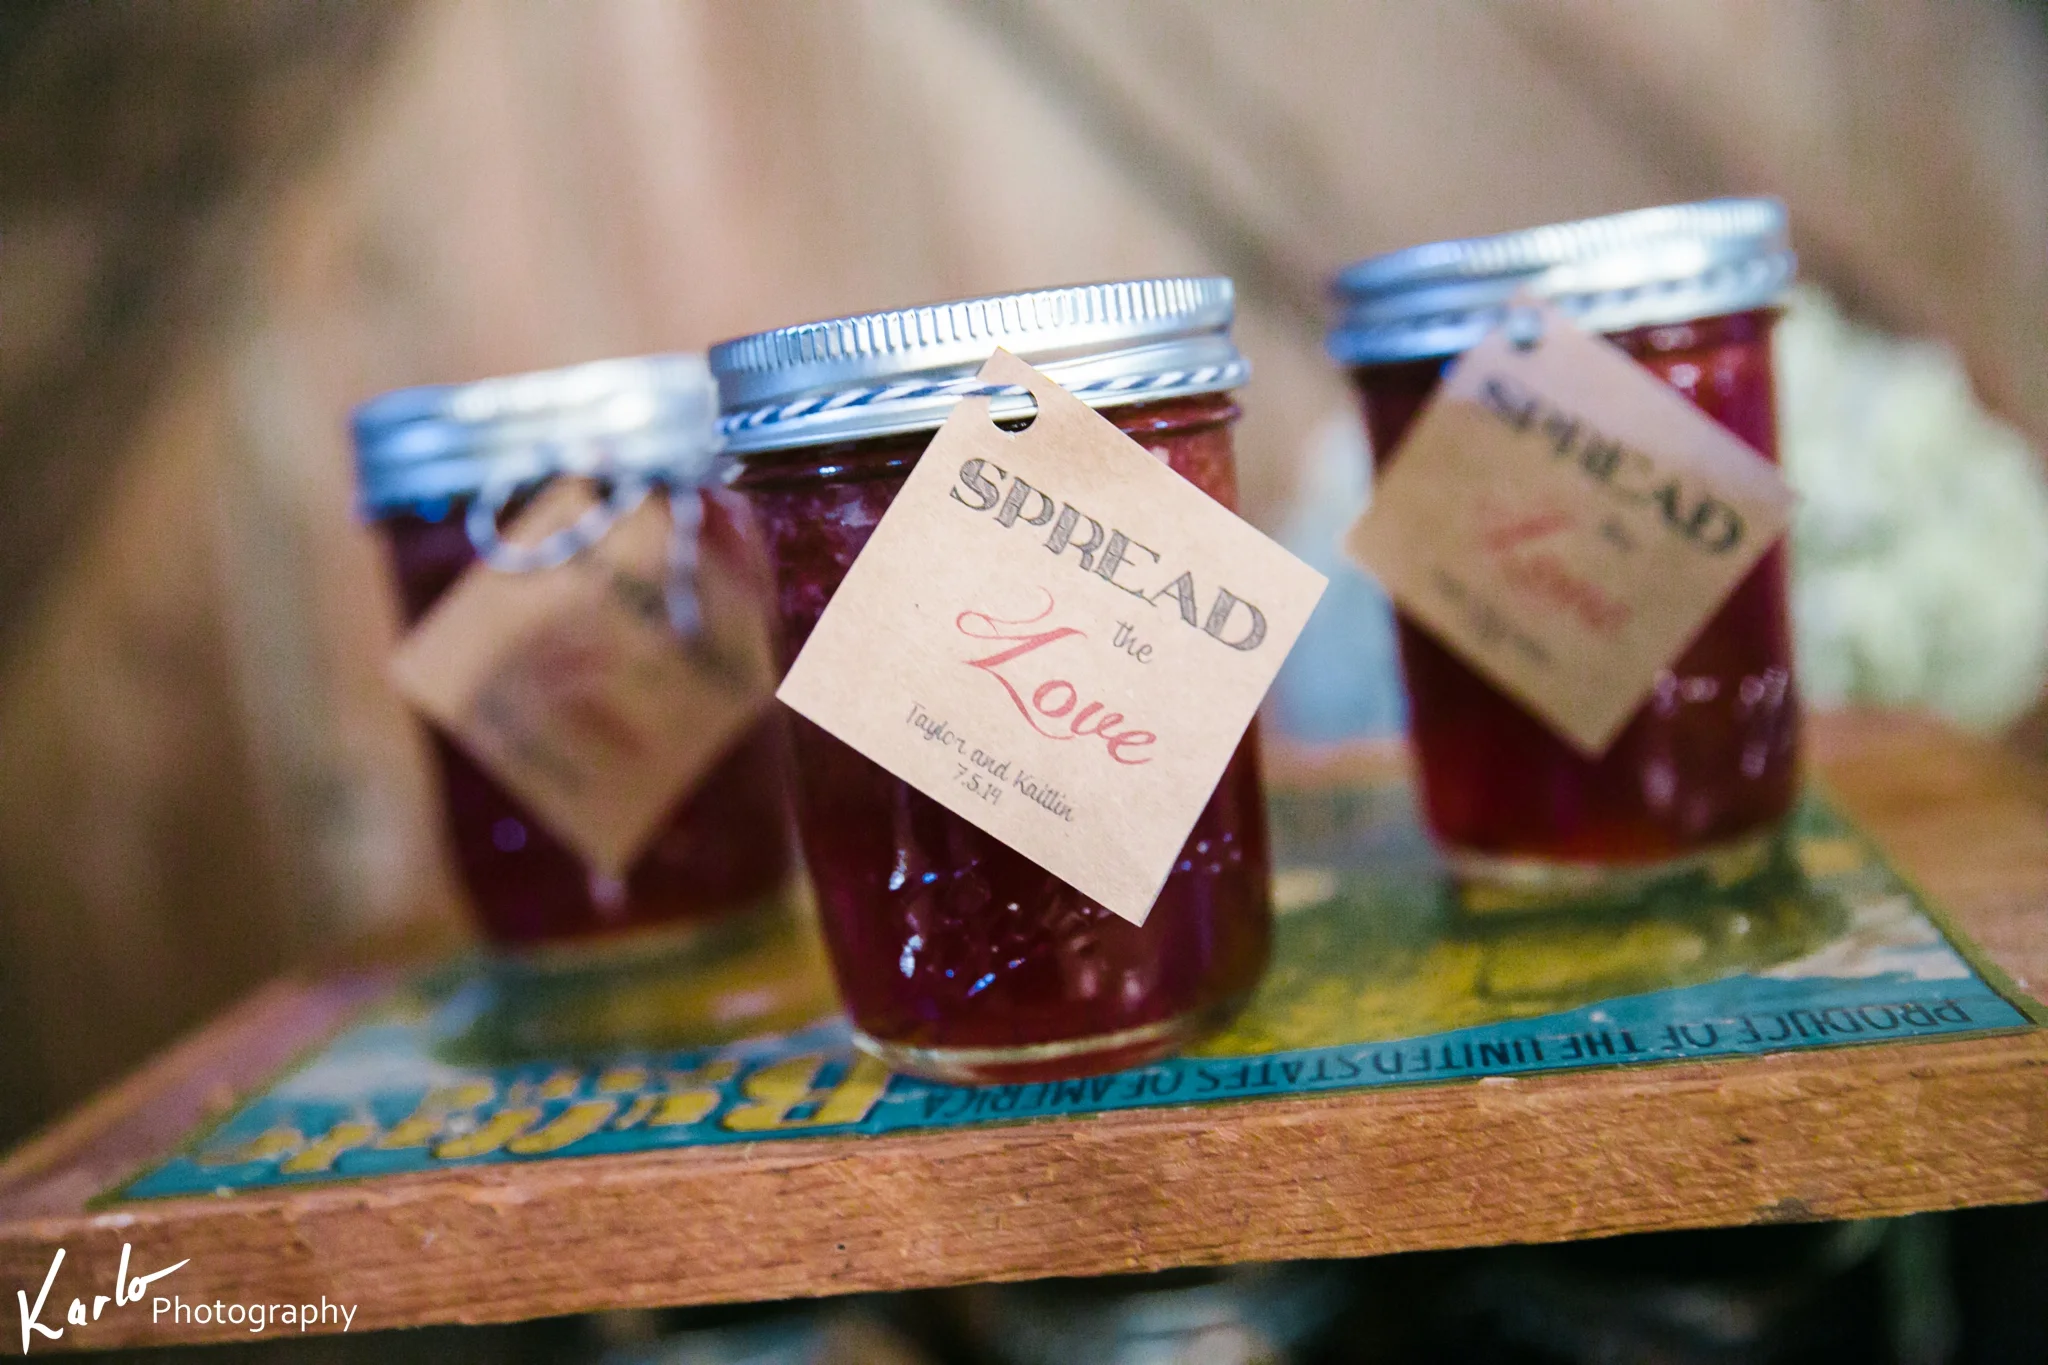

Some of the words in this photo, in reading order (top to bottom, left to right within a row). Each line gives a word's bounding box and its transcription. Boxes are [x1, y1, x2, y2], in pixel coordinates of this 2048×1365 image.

[949, 457, 1267, 652] SPREAD
[1113, 620, 1153, 664] the
[956, 585, 1157, 765] Love
[906, 701, 966, 755] Taylor
[970, 748, 1012, 781] and
[1012, 769, 1075, 822] Kaitlin
[1661, 1023, 1719, 1050] OF
[1738, 998, 1973, 1045] PRODUCE
[1374, 1038, 1545, 1075] UNITED
[1560, 1029, 1648, 1060] THE
[1126, 1068, 1185, 1100] OF
[1196, 1053, 1358, 1094] STATES
